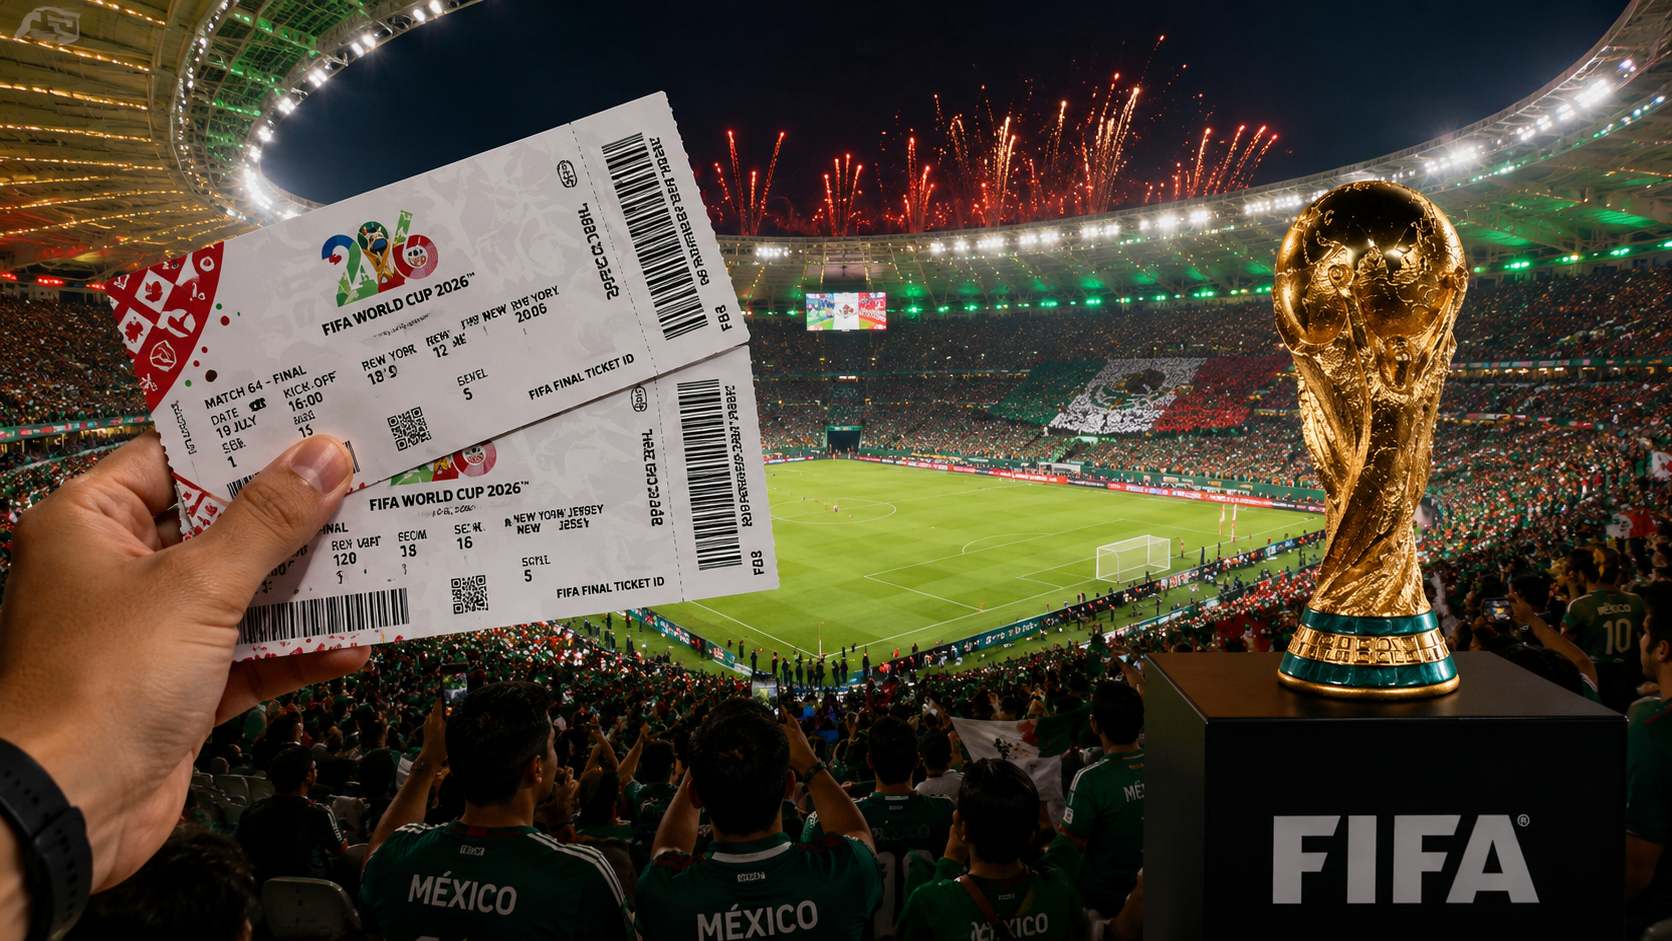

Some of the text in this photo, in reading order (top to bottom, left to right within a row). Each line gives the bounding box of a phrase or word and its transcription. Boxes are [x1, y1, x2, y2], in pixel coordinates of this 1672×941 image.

[321, 315, 353, 337] FIFA
[352, 297, 404, 325] WORLD
[405, 287, 433, 307] CUP
[204, 387, 246, 410] MATCH
[247, 380, 263, 394] 64
[272, 365, 307, 385] FINAL
[528, 353, 635, 401] FIFA FINAL TICKET ID
[288, 391, 323, 413] 16:00
[210, 407, 239, 426] DATE
[233, 414, 258, 433] JULY
[369, 496, 400, 512] FIFA
[401, 489, 454, 508] WORLD
[456, 485, 485, 501] CUP
[517, 522, 541, 535] NEW
[456, 535, 473, 550] 16
[524, 569, 532, 583] 5
[556, 576, 665, 598] FIFA FINAL TICKET ID
[1602, 618, 1632, 655] 10
[407, 870, 518, 916] MÉXICO
[696, 899, 818, 941] MÉXICO
